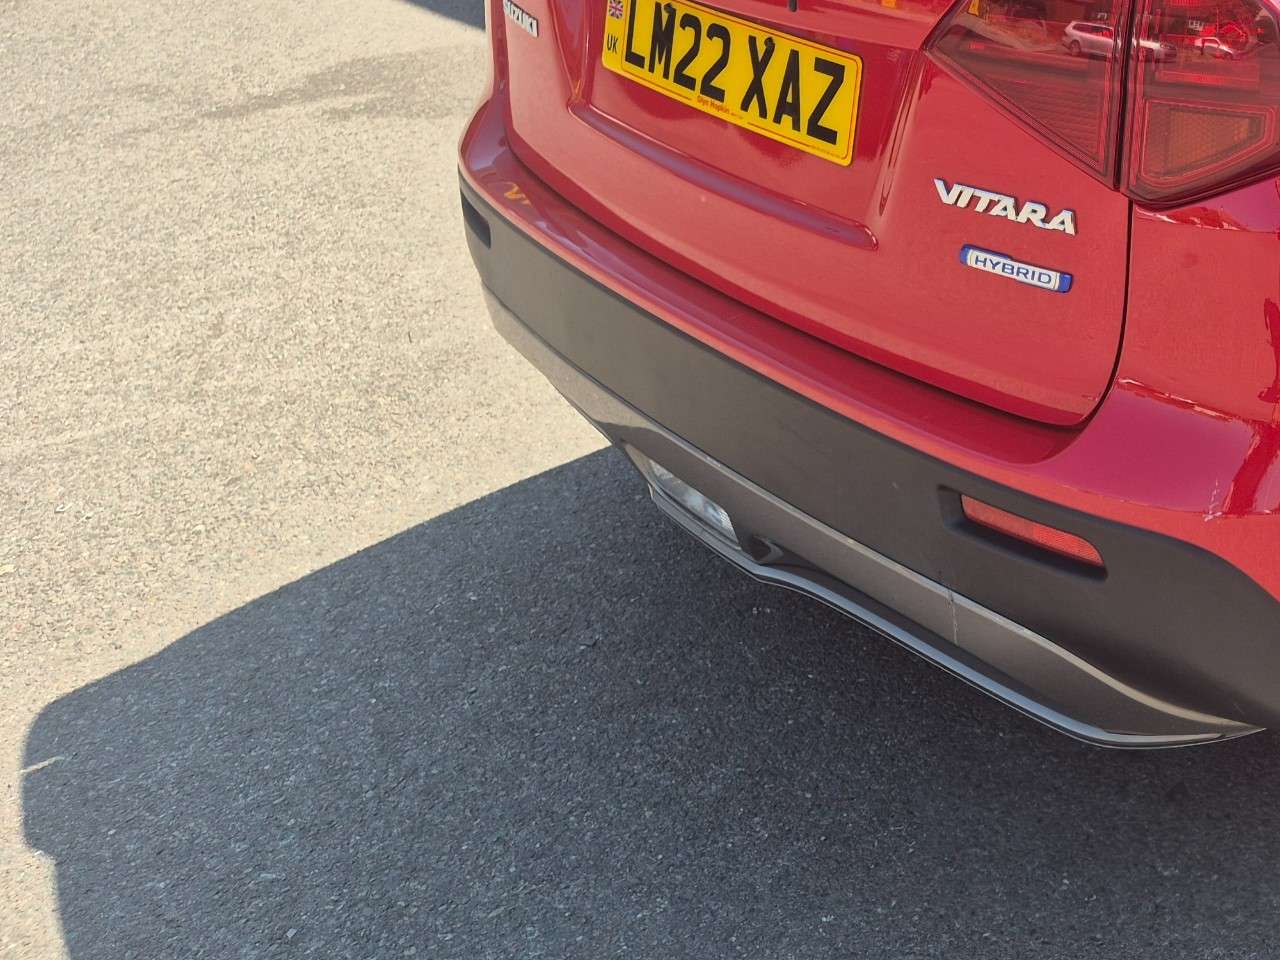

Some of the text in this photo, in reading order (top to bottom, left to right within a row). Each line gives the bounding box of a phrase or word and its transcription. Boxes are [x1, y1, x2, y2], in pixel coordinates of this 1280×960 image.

[606, 33, 618, 54] UK
[740, 35, 846, 146] XAZ
[934, 177, 1077, 236] VITARA
[974, 253, 1052, 285] HYBRID
